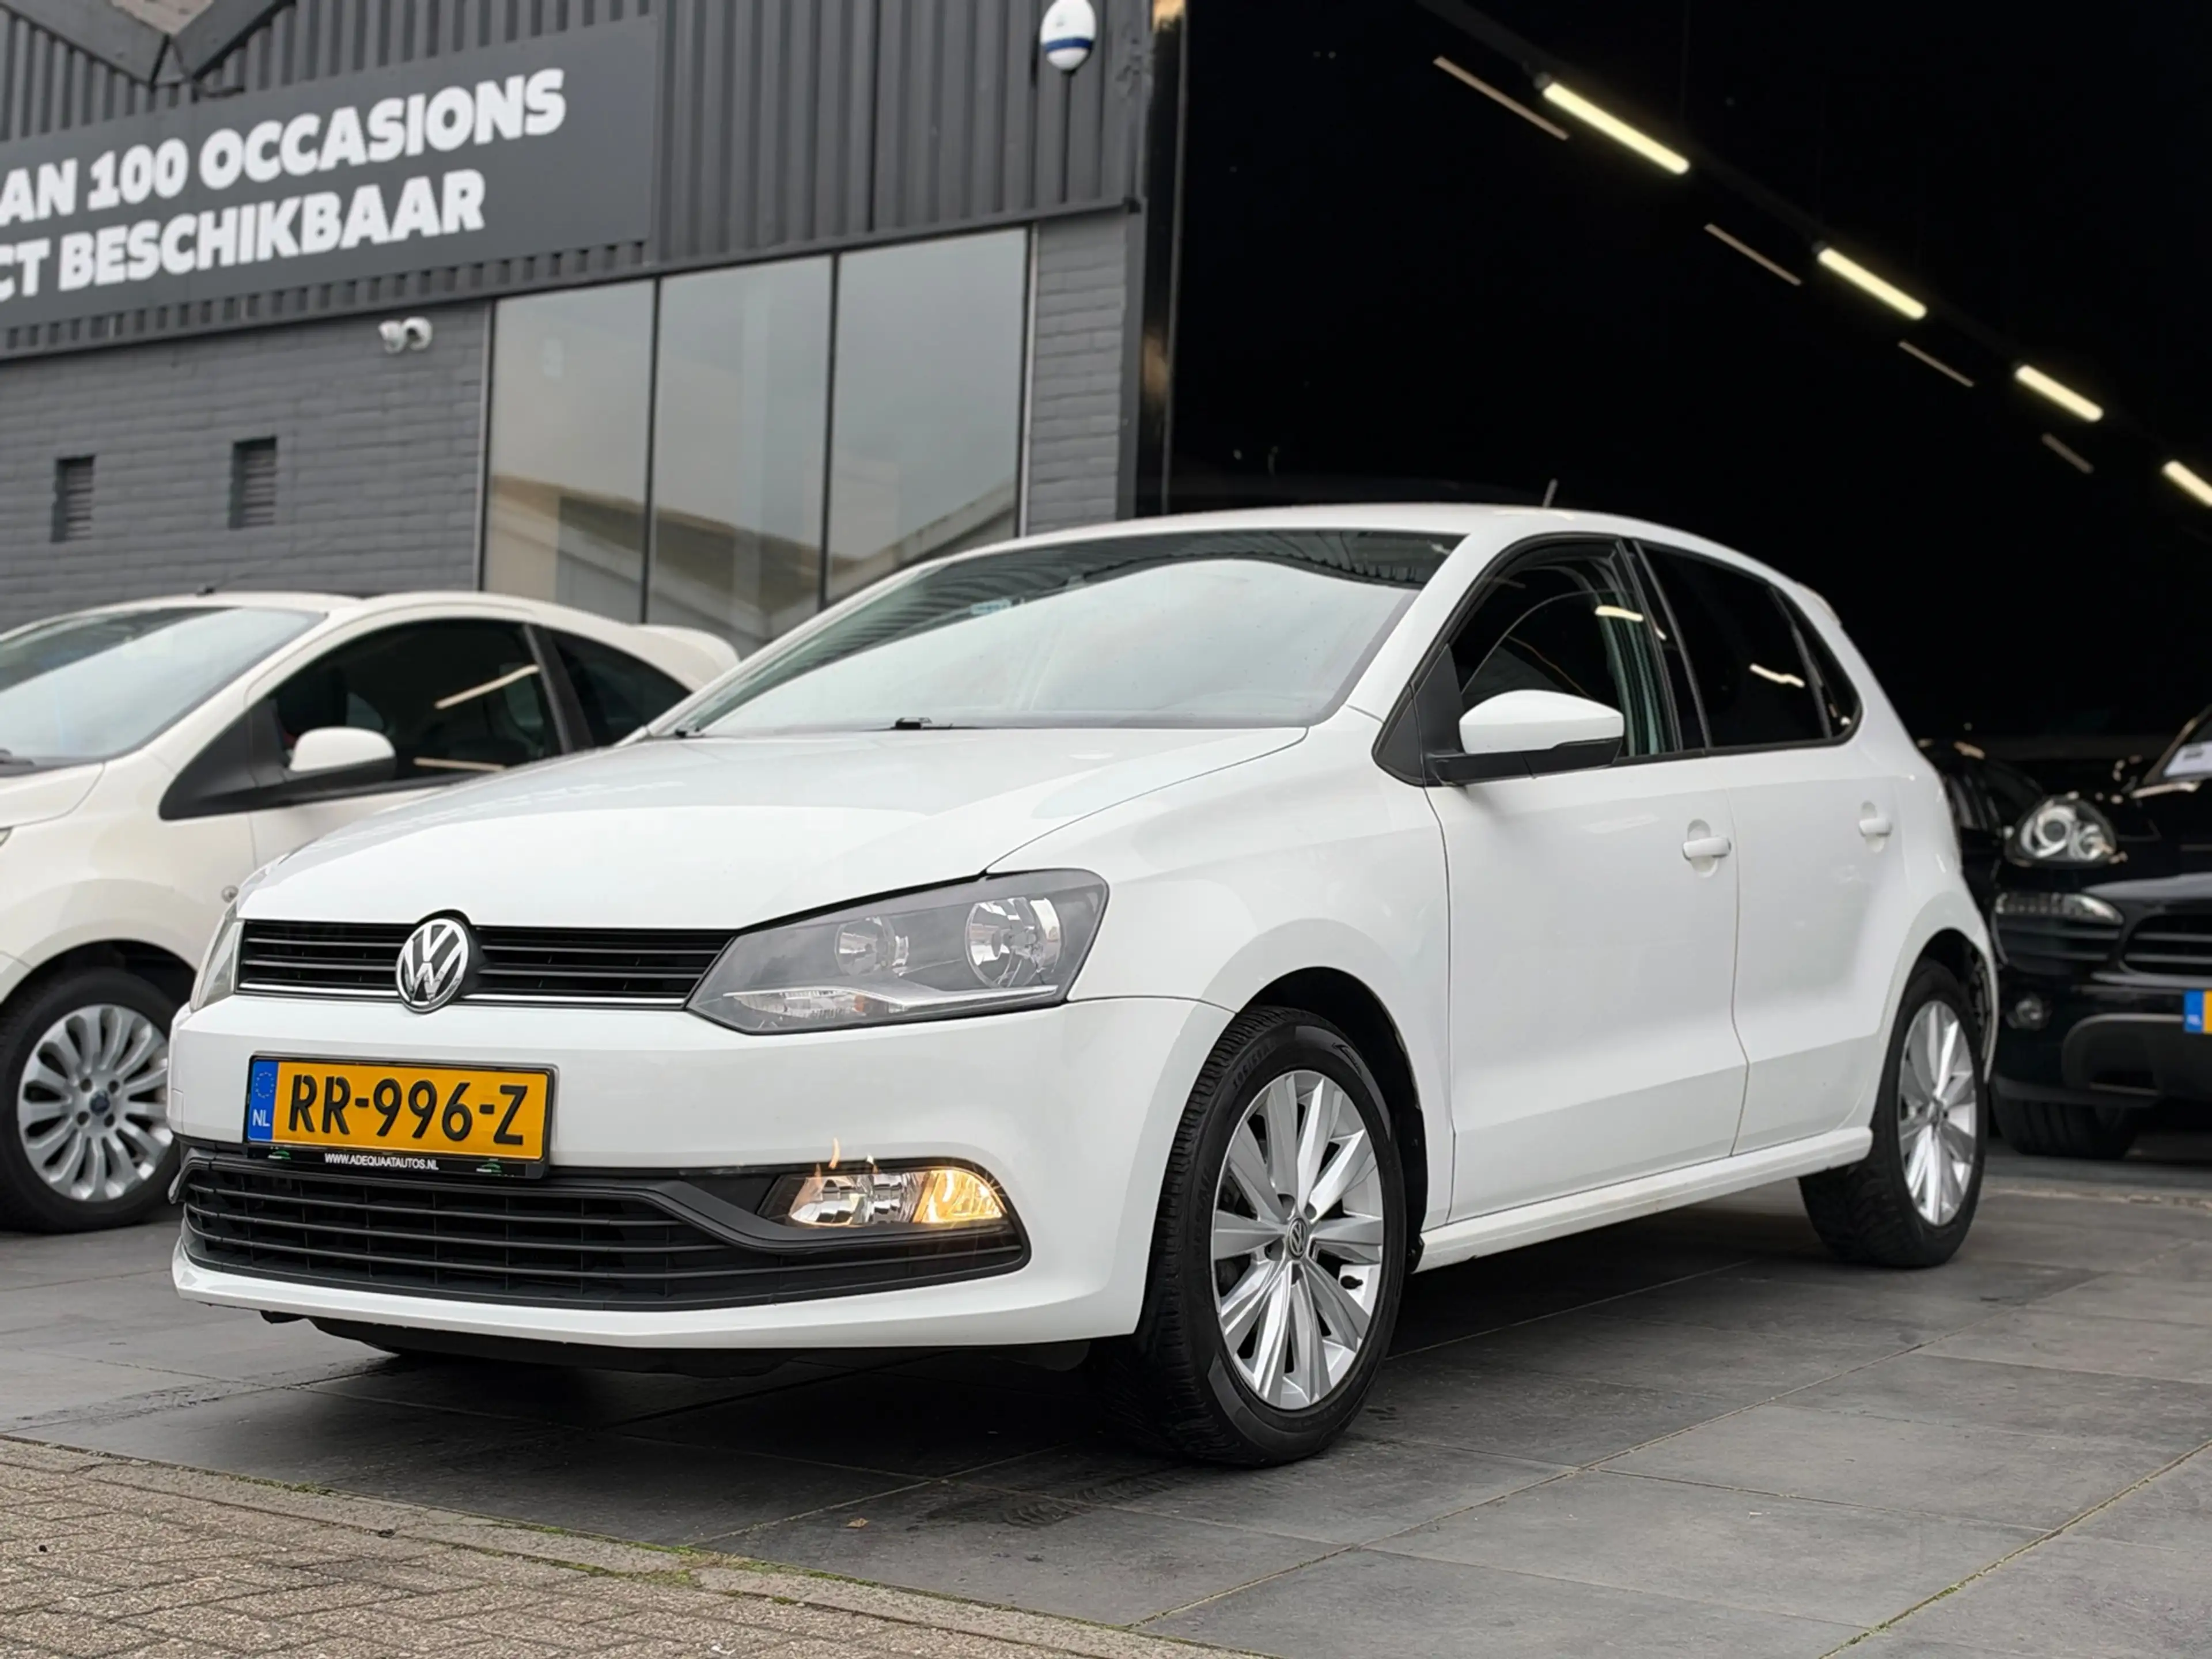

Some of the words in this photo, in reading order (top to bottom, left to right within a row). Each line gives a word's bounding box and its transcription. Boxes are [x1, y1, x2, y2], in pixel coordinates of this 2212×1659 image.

[0, 158, 78, 226] AN
[88, 138, 189, 210] 100
[199, 68, 566, 190] OCCASIONS
[58, 169, 485, 291] BESCHIKBAAR
[253, 1109, 270, 1127] NL
[288, 1074, 528, 1146] RR-996-Z
[324, 1153, 440, 1171] WWW.ADEQUAATAUTOS.NL
